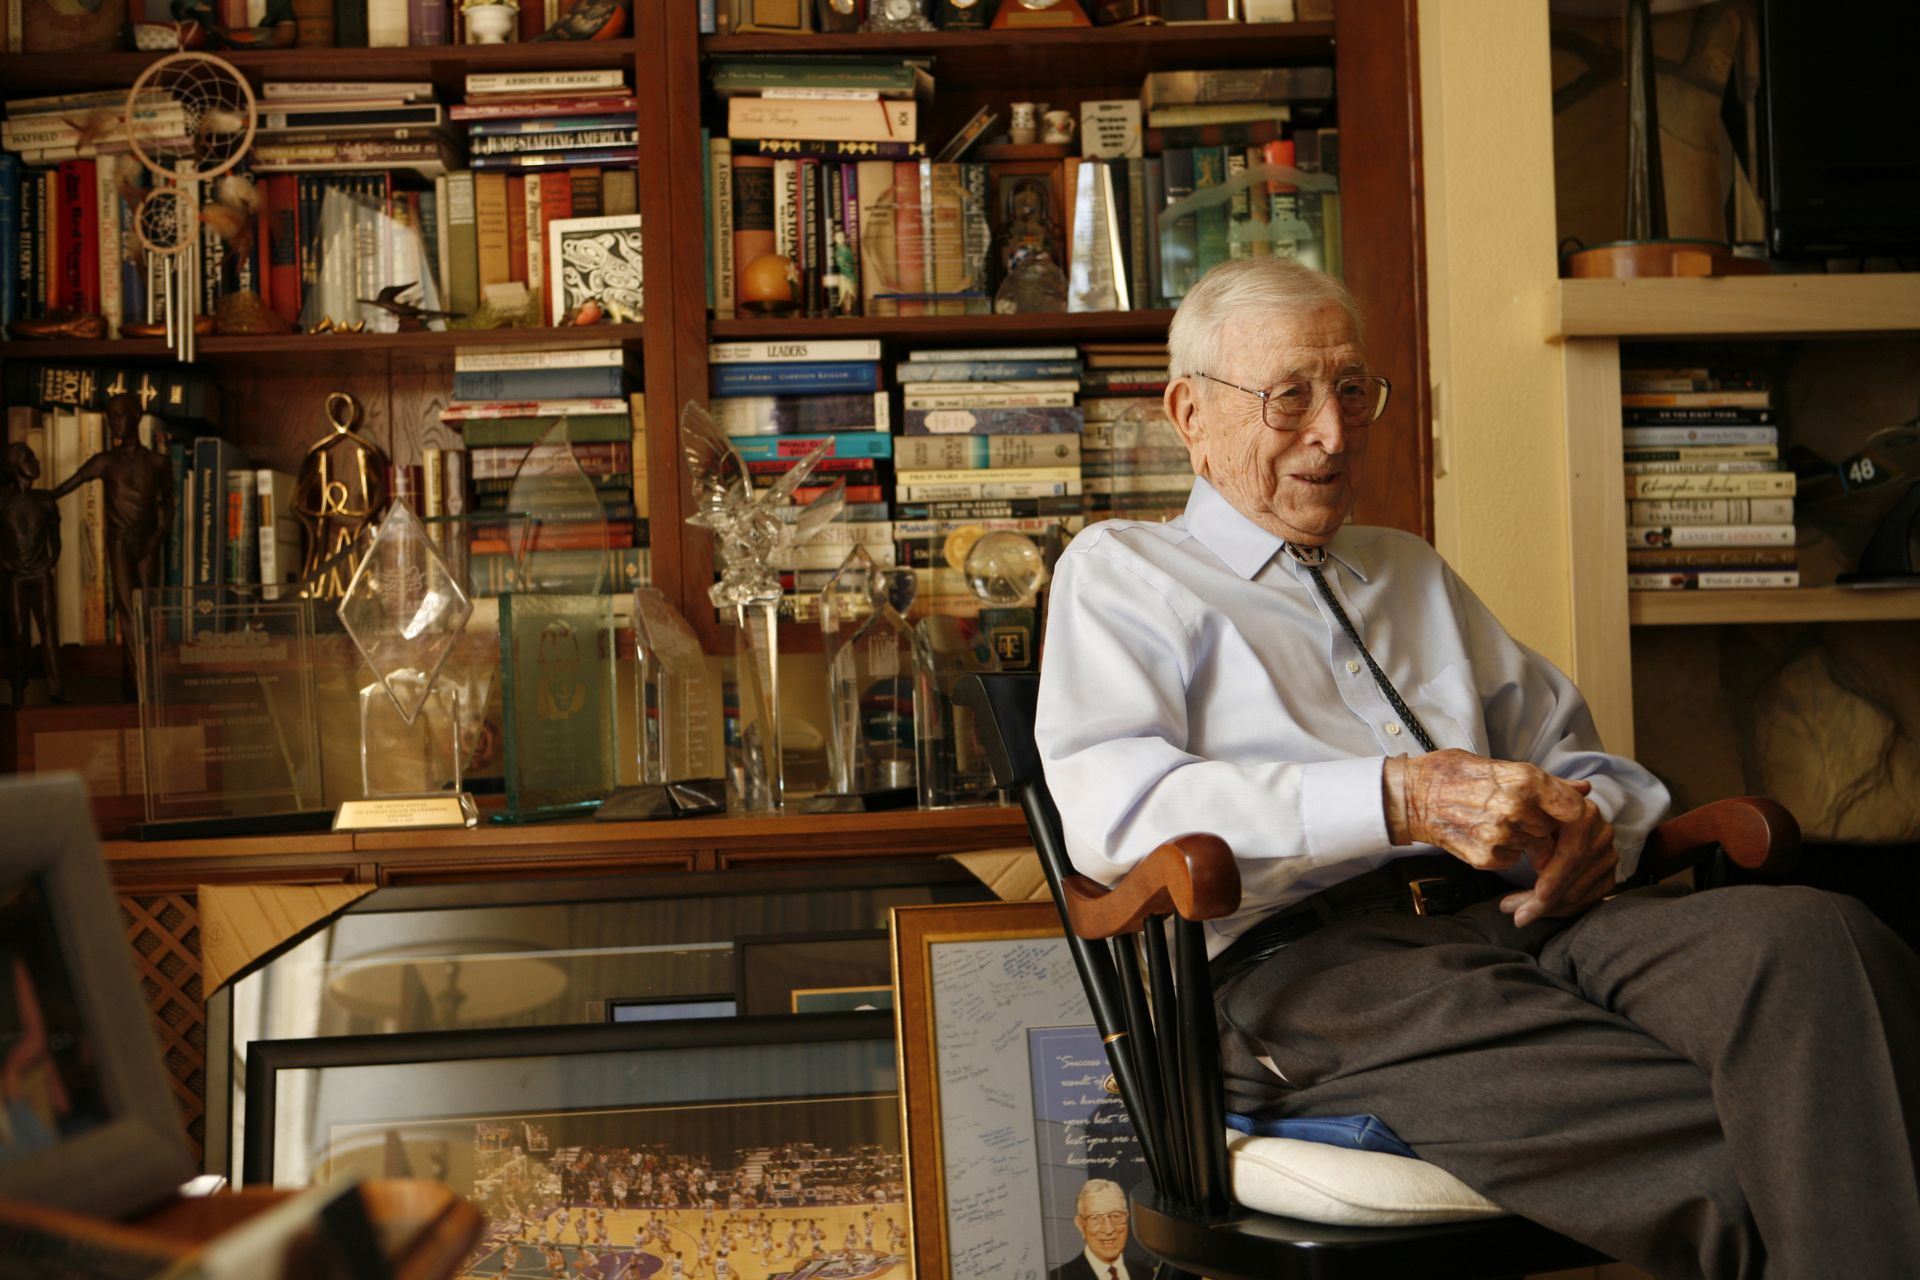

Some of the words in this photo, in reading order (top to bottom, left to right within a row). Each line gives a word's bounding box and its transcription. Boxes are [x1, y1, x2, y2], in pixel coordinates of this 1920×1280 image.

[576, 131, 625, 146] AMERICA
[718, 171, 729, 198] Creek
[719, 199, 730, 228] Called
[720, 230, 731, 272] Wounded
[721, 275, 732, 298] Knee
[767, 344, 808, 358] LEADERS
[63, 369, 80, 404] POE
[1849, 458, 1875, 483] 48
[1680, 532, 1708, 541] LAND
[1710, 531, 1725, 540] OF
[1727, 530, 1773, 540] LINCOLN
[1704, 575, 1733, 585] Wisdom
[1744, 575, 1755, 585] the
[1061, 1074, 1095, 1087] result
[1063, 1098, 1077, 1106] in
[1080, 1095, 1125, 1108] knowing
[1063, 1117, 1090, 1133] your
[1094, 1112, 1118, 1124] best
[1065, 1133, 1090, 1145] best
[1087, 1137, 1108, 1152] you
